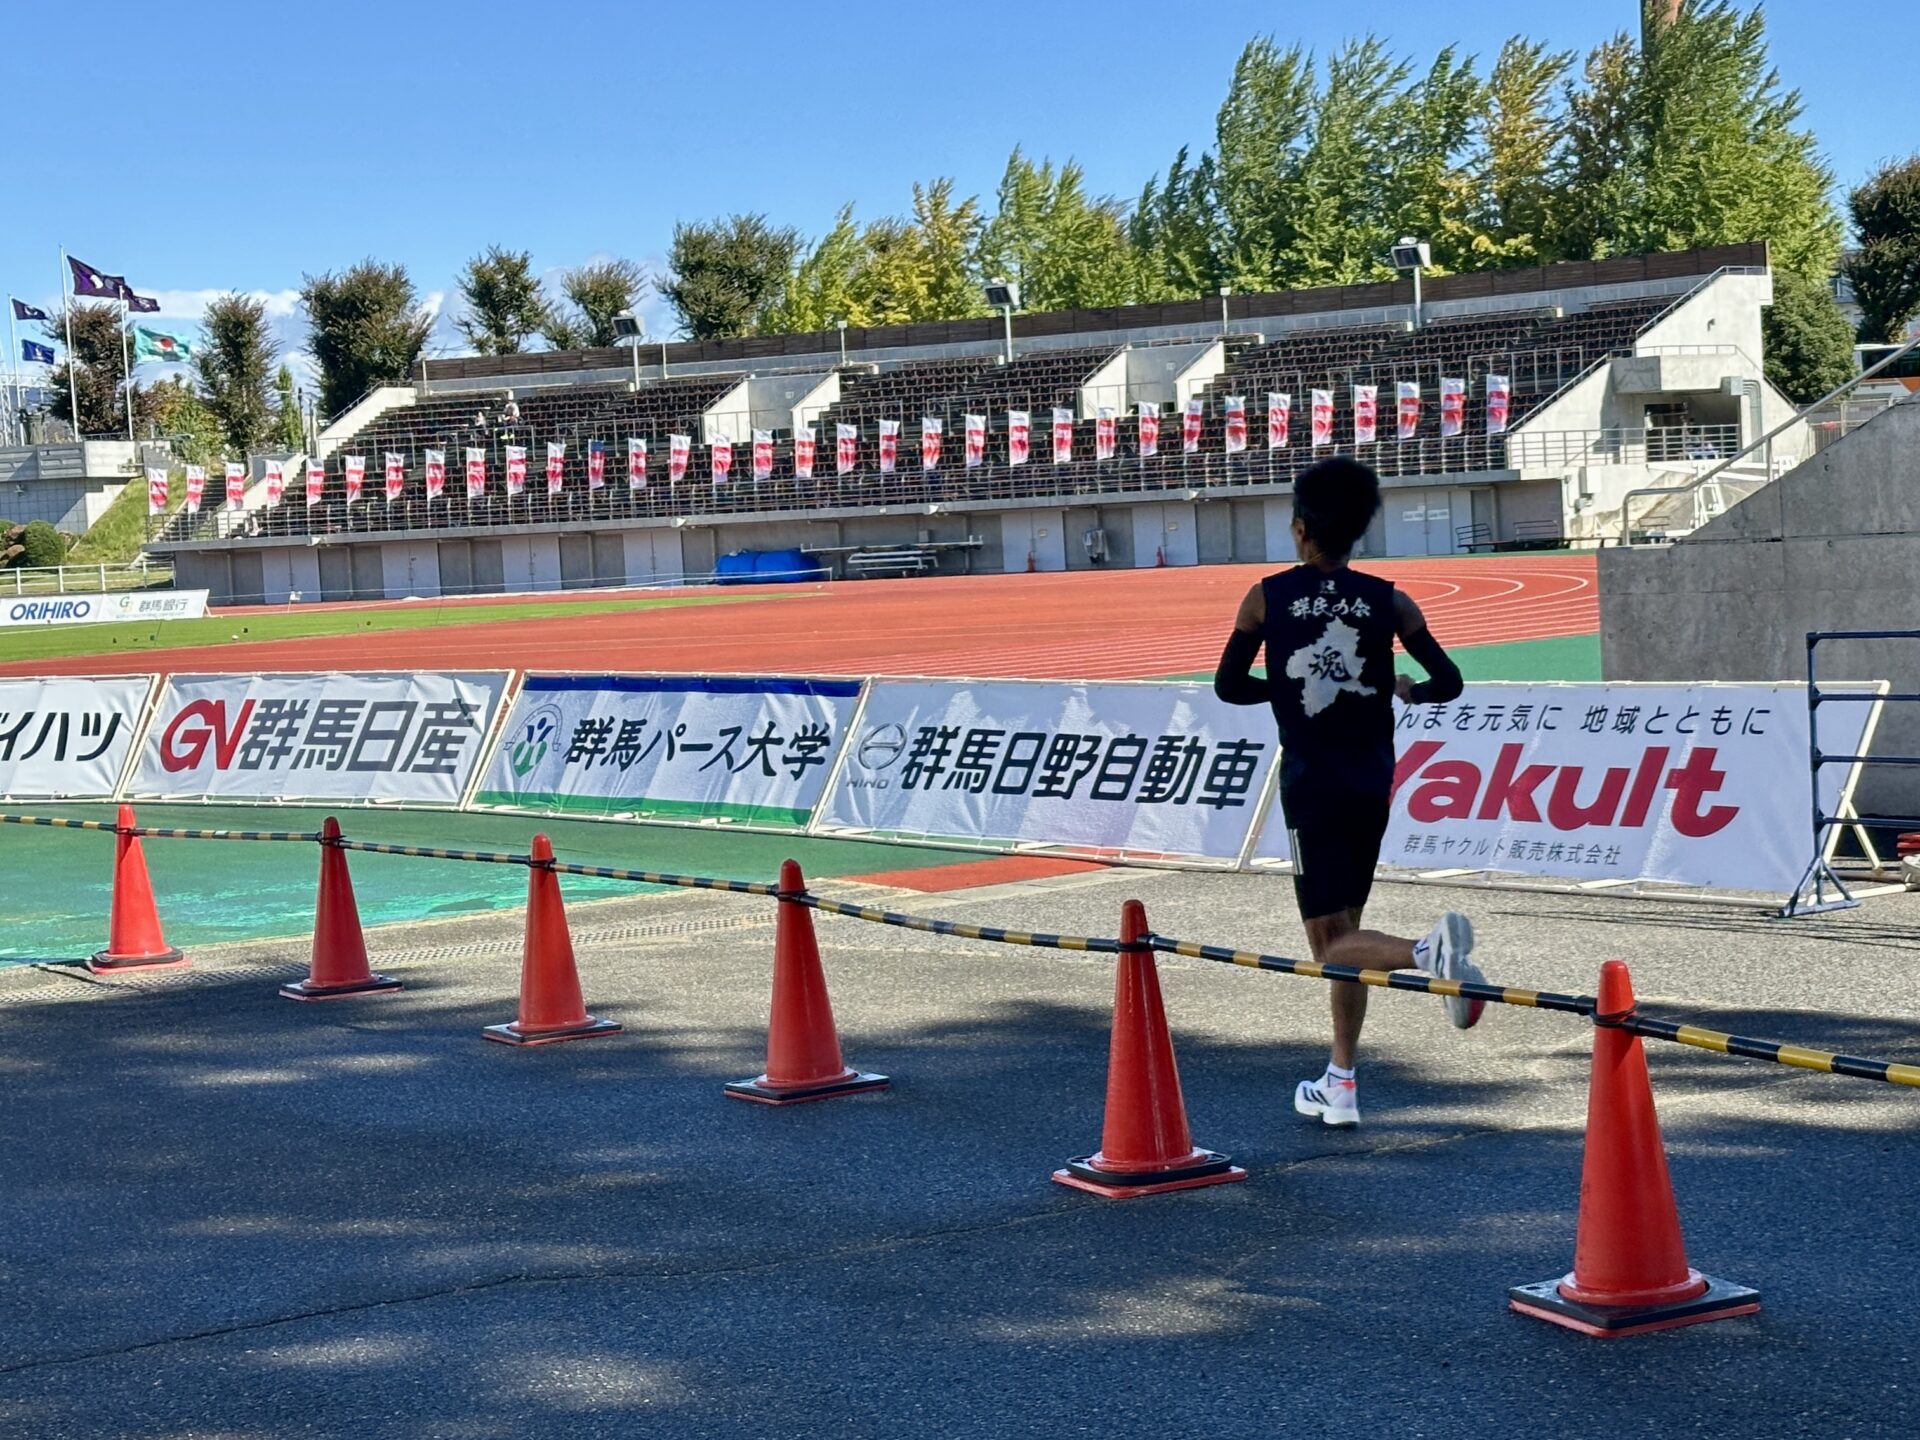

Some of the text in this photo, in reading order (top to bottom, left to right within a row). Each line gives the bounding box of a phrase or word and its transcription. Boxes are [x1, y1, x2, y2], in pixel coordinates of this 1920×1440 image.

[10, 601, 90, 621] ORIHIRO
[1309, 645, 1349, 683] 魂
[0, 711, 123, 762] イハツ
[238, 698, 481, 773] 群馬日産
[1396, 703, 1771, 736] んまを元気に 地域とともに
[562, 715, 831, 781] 群馬パース大学
[846, 779, 889, 790] HINO
[900, 725, 1265, 810] 群馬日野自動車
[1403, 834, 1622, 866] 群馬ヤクルト販売株式会社
